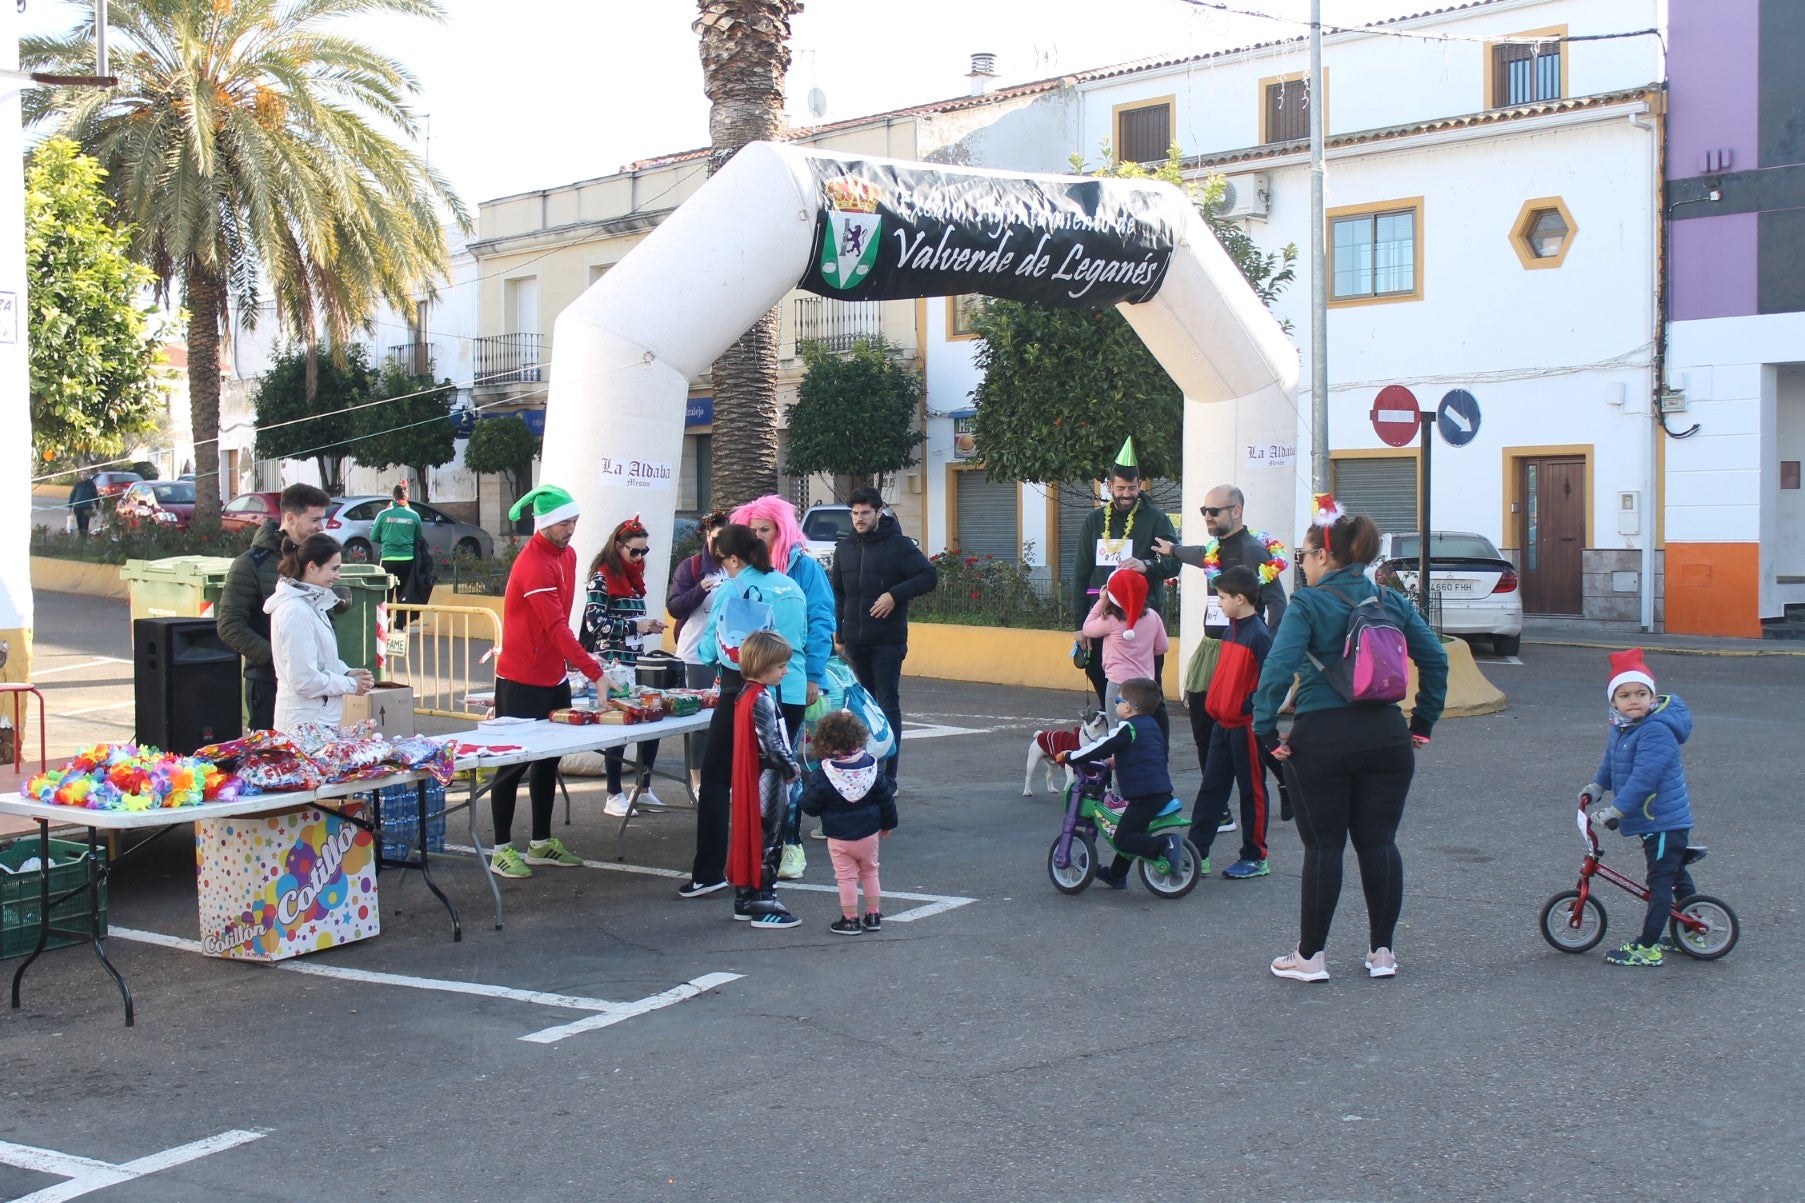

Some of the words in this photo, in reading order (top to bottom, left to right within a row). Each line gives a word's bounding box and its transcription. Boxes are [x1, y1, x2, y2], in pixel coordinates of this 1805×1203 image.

[893, 224, 1014, 273] Valverde
[1016, 233, 1051, 278] de
[1051, 244, 1158, 298] Leganés
[1247, 445, 1264, 459] La
[601, 458, 622, 475] La
[628, 461, 671, 479] Aldaba
[1455, 583, 1472, 591] FHH
